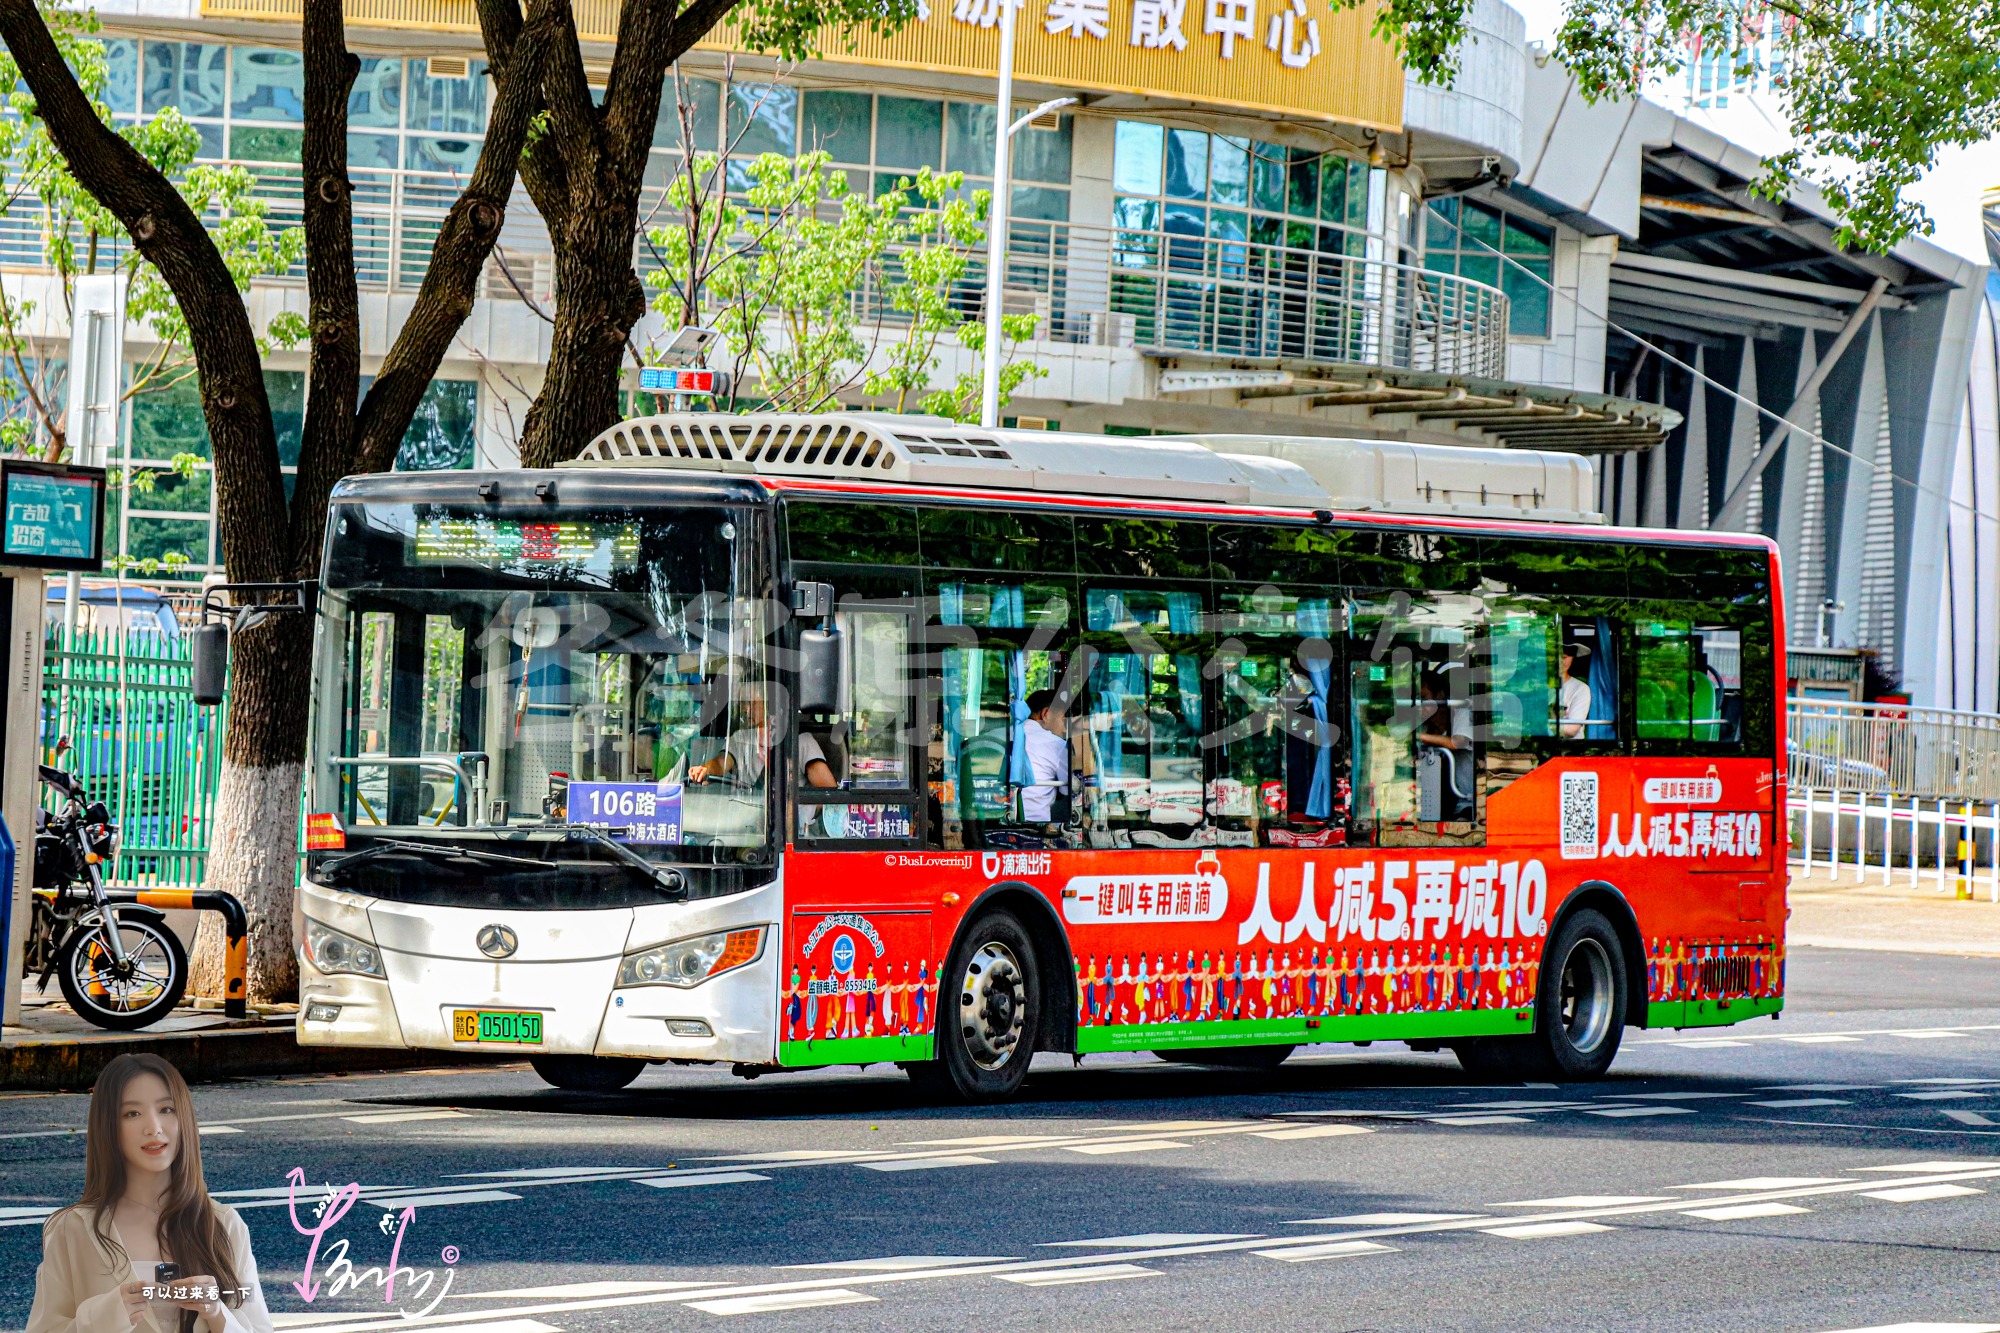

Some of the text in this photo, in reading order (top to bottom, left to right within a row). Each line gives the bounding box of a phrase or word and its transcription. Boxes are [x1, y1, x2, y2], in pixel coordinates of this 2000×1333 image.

[11, 524, 46, 547] 招商
[589, 790, 657, 816] 106路
[1001, 853, 1051, 876] 滴滴出行
[1078, 875, 1212, 917] 一键叫车用滴滴
